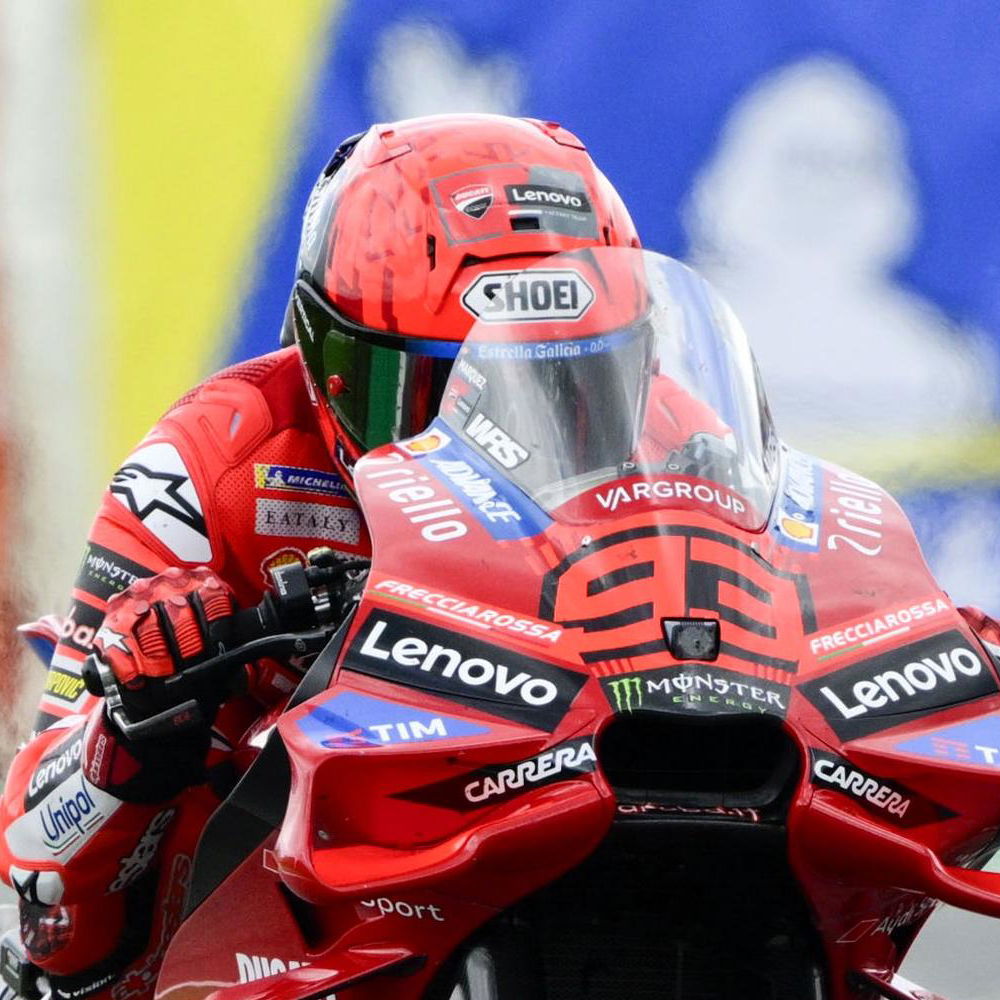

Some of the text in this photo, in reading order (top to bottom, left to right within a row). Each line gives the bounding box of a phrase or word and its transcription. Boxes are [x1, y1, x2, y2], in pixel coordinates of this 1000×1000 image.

[512, 188, 582, 207] Lenovo
[483, 280, 578, 313] SHOEI
[478, 344, 533, 360] Estrella
[535, 342, 582, 359] Galicia
[266, 511, 347, 532] EATALY
[87, 555, 137, 585] MONSTE
[375, 580, 563, 643] FRECCIAROSSA
[809, 599, 949, 654] FRECCIAROSSA
[360, 621, 558, 706] Lenovo
[820, 648, 982, 719] Lenovo
[646, 673, 786, 710] MONSTER
[672, 695, 767, 715] ENERGY
[369, 718, 448, 742] TIM
[28, 738, 82, 798] Lenovo
[464, 742, 598, 803] CARRERA
[813, 760, 911, 818] CARRERA
[40, 776, 95, 842] Unipol
